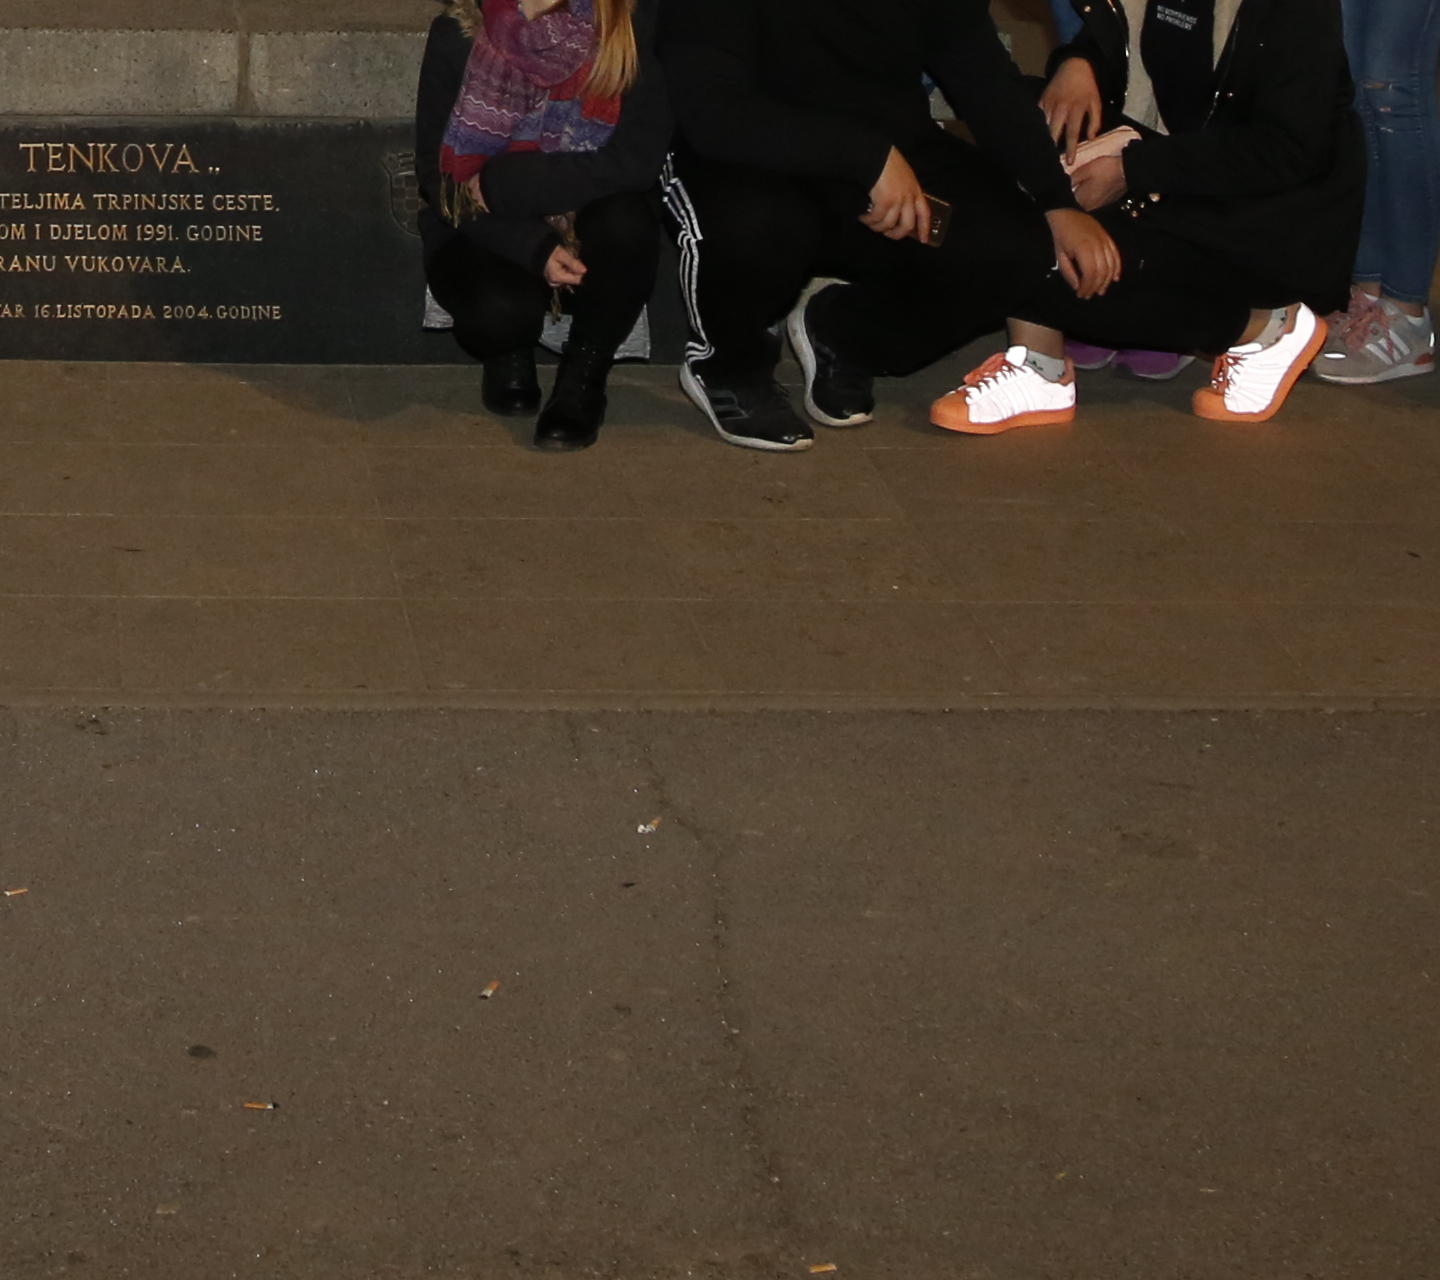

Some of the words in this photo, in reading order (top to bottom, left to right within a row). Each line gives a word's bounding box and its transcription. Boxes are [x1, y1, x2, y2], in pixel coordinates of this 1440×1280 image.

[93, 193, 205, 211] TRPINJSKE
[212, 193, 280, 212] CESTE.
[35, 223, 41, 240] I
[49, 223, 127, 241] DJELOM
[136, 223, 179, 241] 1991.
[186, 224, 264, 241] GODINE
[64, 255, 192, 273] VUKOVARA.
